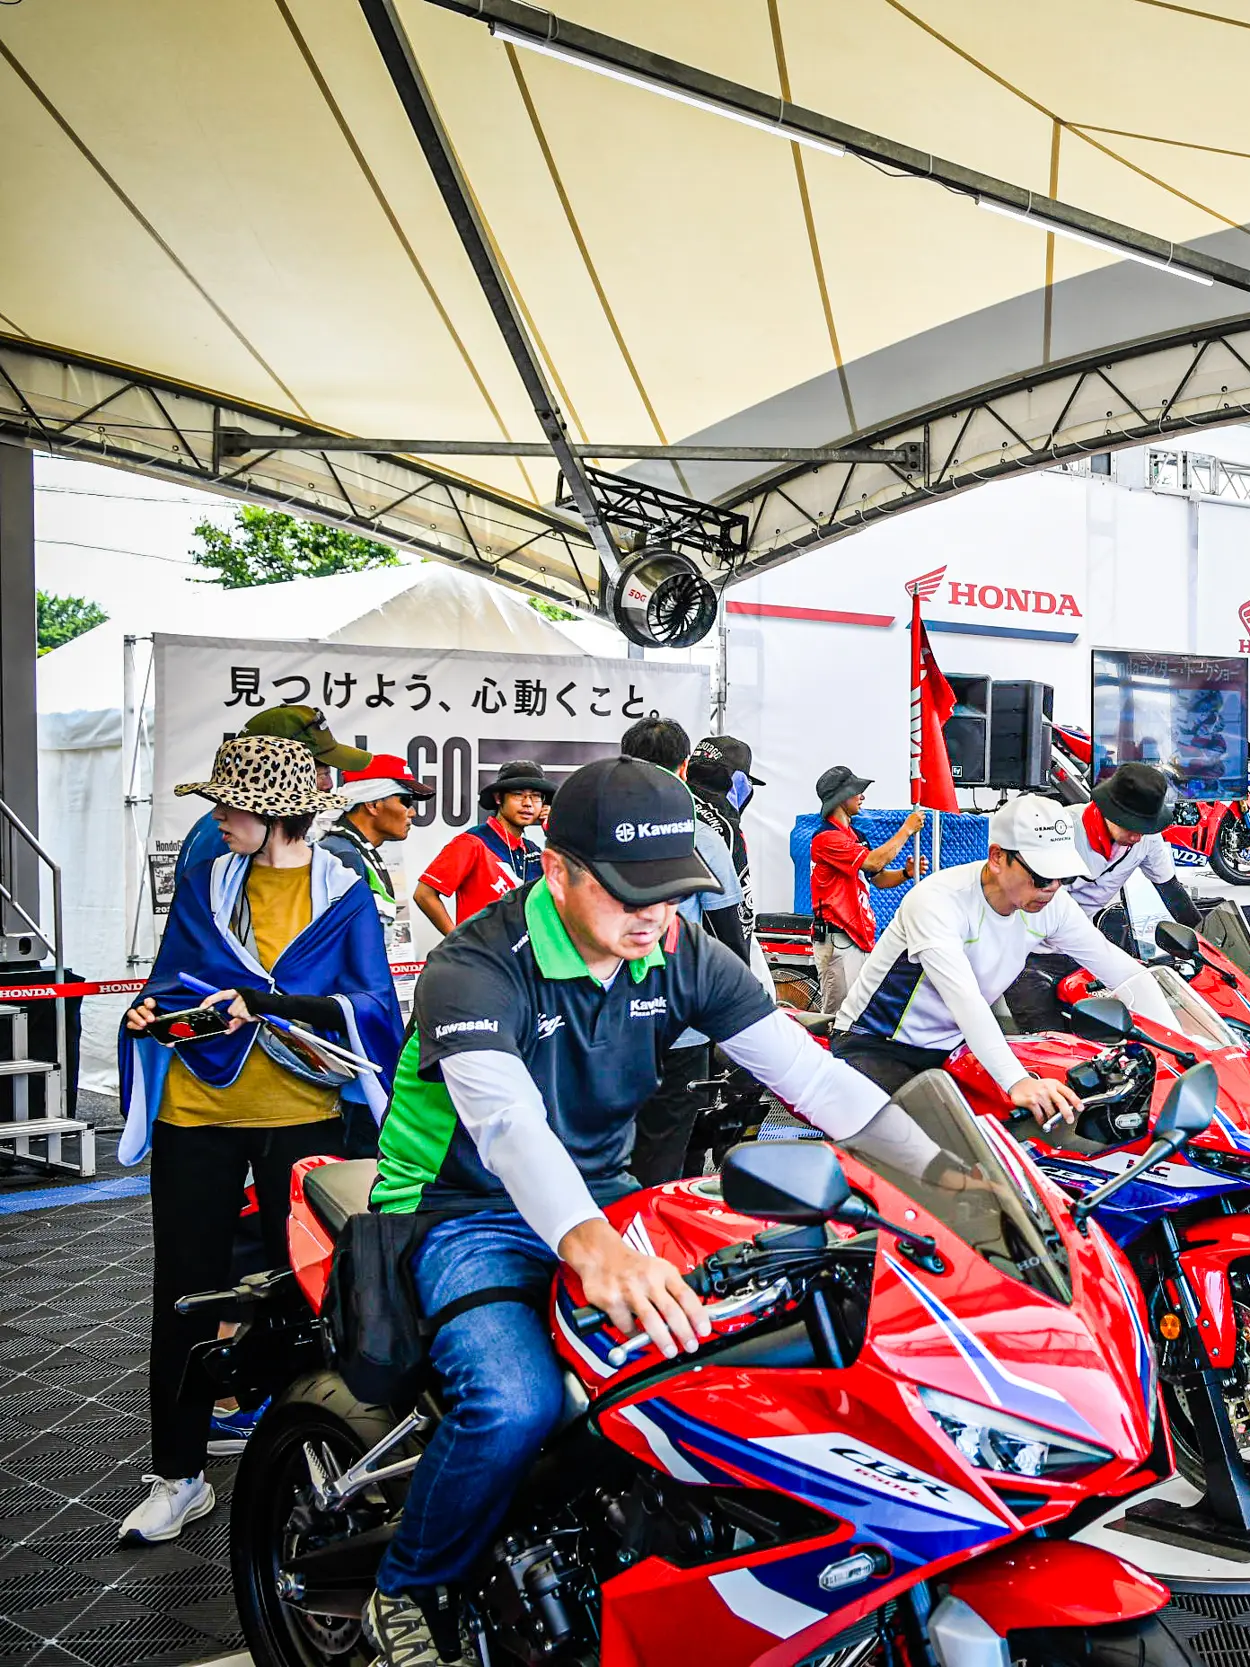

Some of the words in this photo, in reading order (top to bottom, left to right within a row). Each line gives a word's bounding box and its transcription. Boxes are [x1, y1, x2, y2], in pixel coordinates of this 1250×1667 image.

[948, 581, 1083, 618] HONDA
[224, 666, 661, 720] 見つけよう、心動くこと。
[390, 963, 424, 974] ONDA
[0, 987, 57, 999] HONDA
[99, 982, 146, 993] HOND
[435, 1018, 499, 1039] Kawasaki
[829, 1447, 953, 1504] CBR
